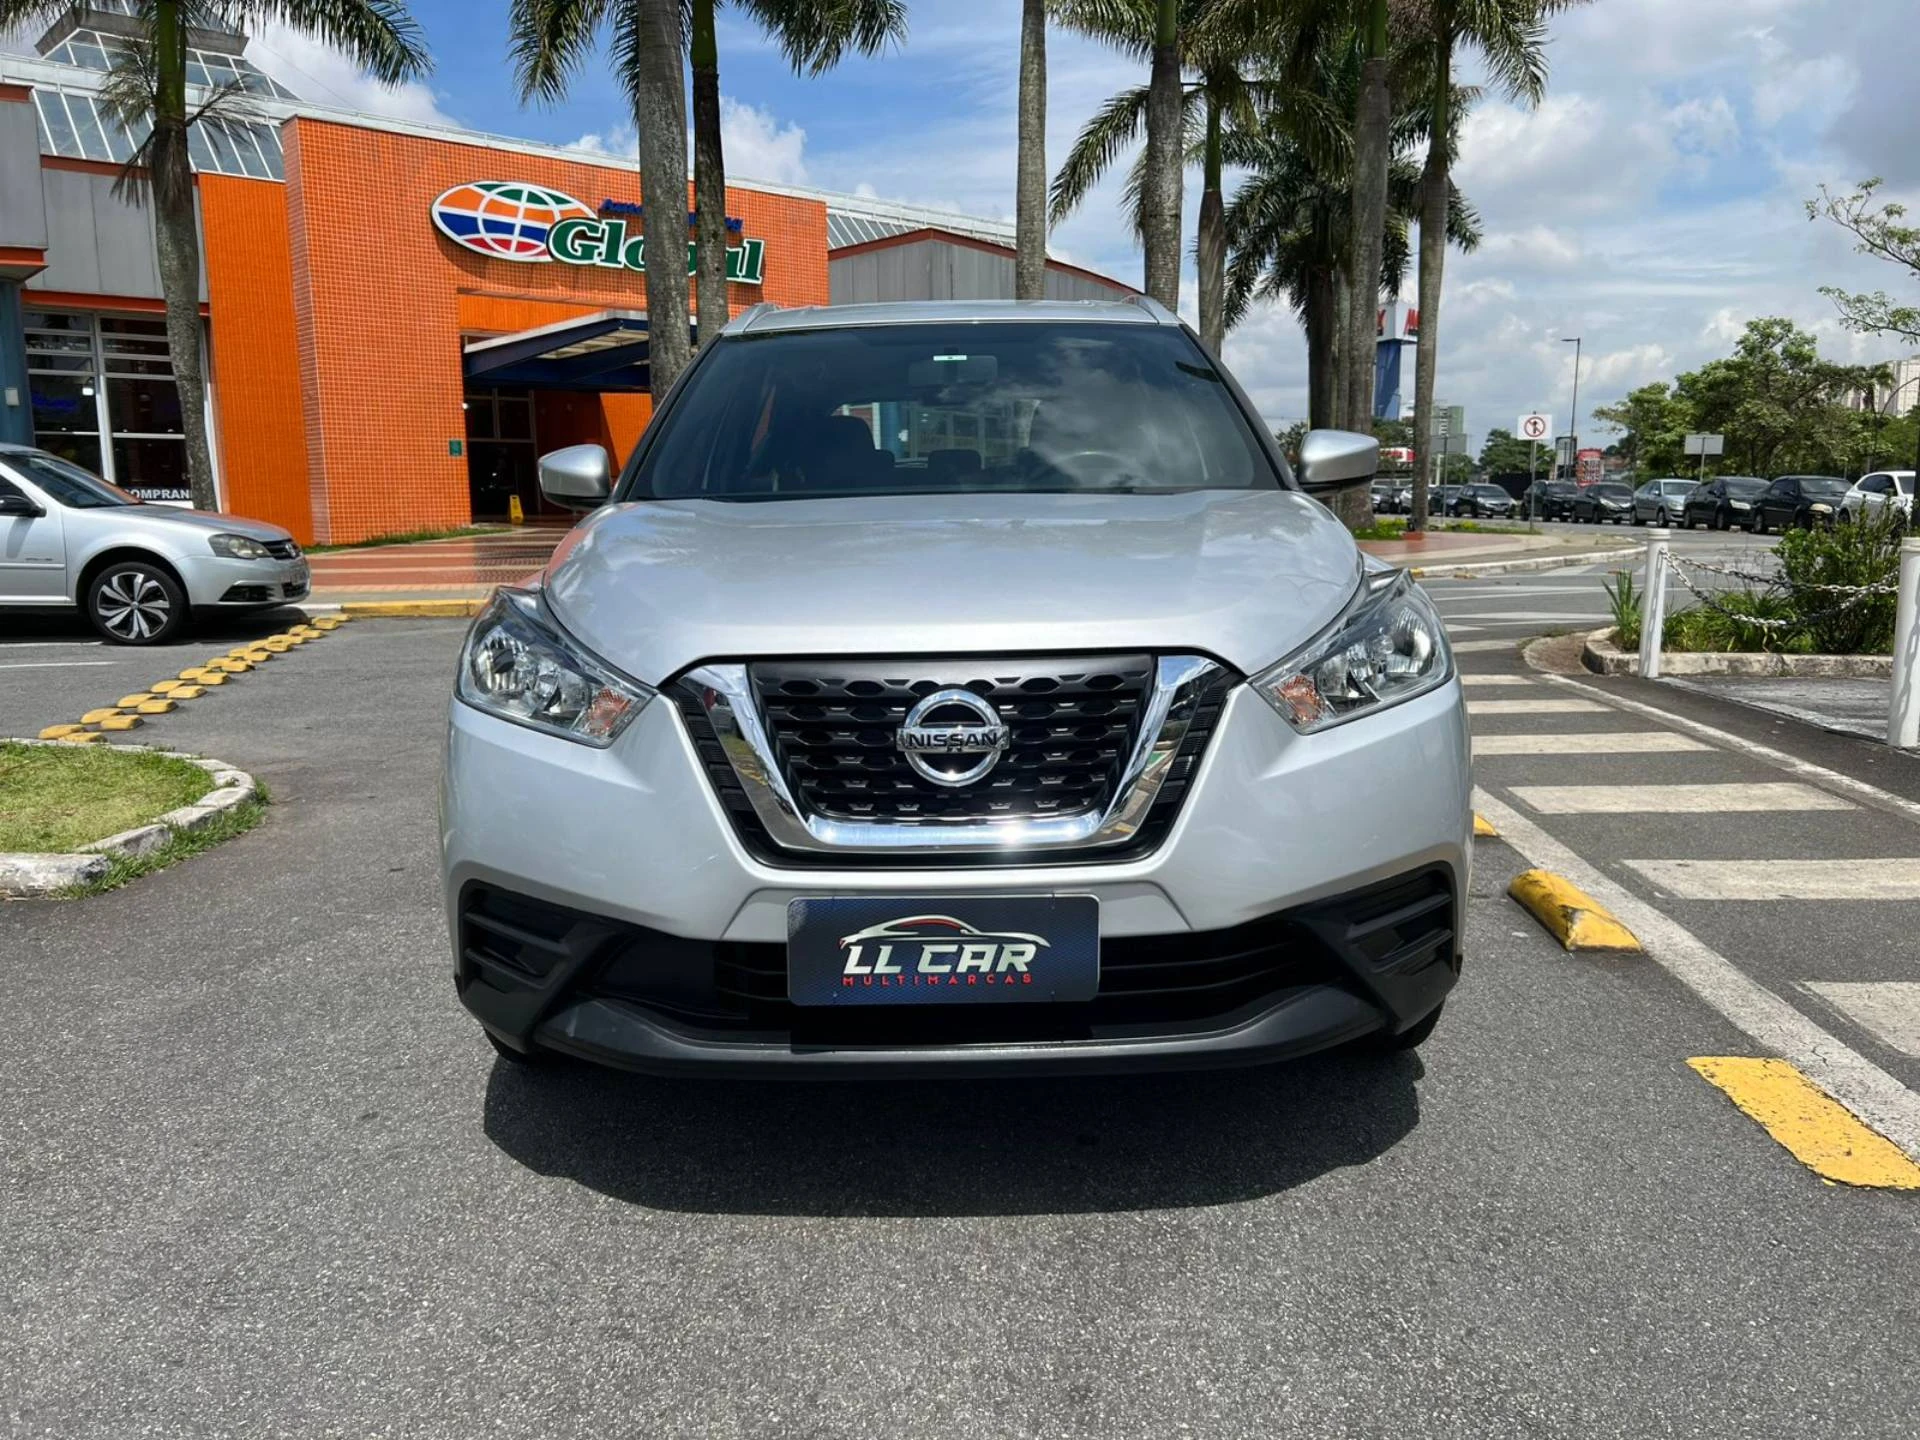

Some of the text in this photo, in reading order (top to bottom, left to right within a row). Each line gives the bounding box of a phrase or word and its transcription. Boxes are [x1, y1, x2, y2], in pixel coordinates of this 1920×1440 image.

[907, 732, 998, 747] NISSAN
[843, 944, 1037, 974] LL CAR
[842, 974, 1033, 986] MULTIMARCAS
